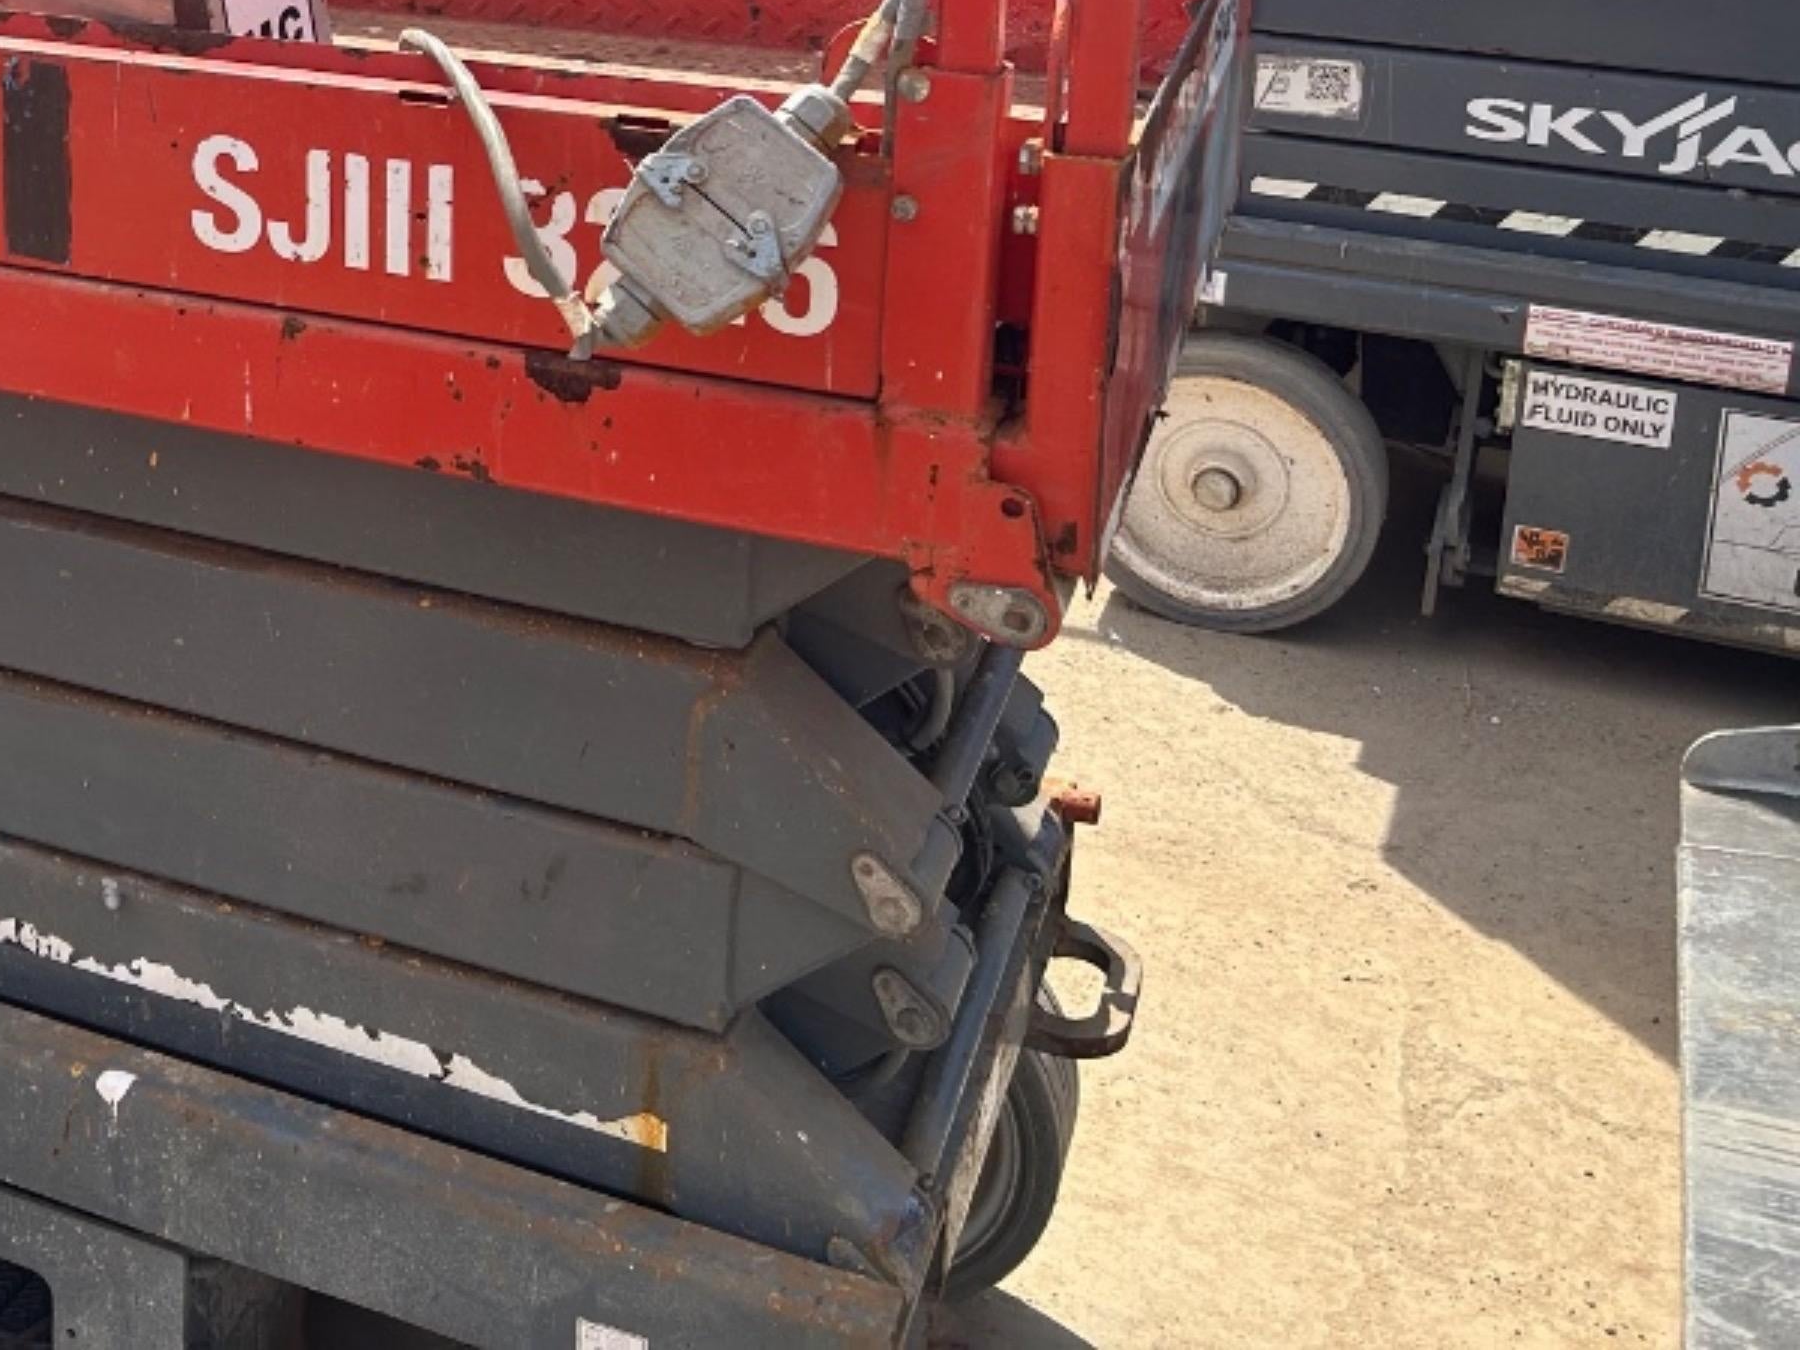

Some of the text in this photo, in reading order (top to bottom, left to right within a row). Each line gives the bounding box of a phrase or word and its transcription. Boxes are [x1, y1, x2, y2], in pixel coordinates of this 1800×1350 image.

[1464, 91, 1800, 176] SKYJA
[190, 133, 454, 283] SJIII
[1527, 401, 1666, 440] FLUID ONLY
[1531, 377, 1670, 416] HYDRAULIC
